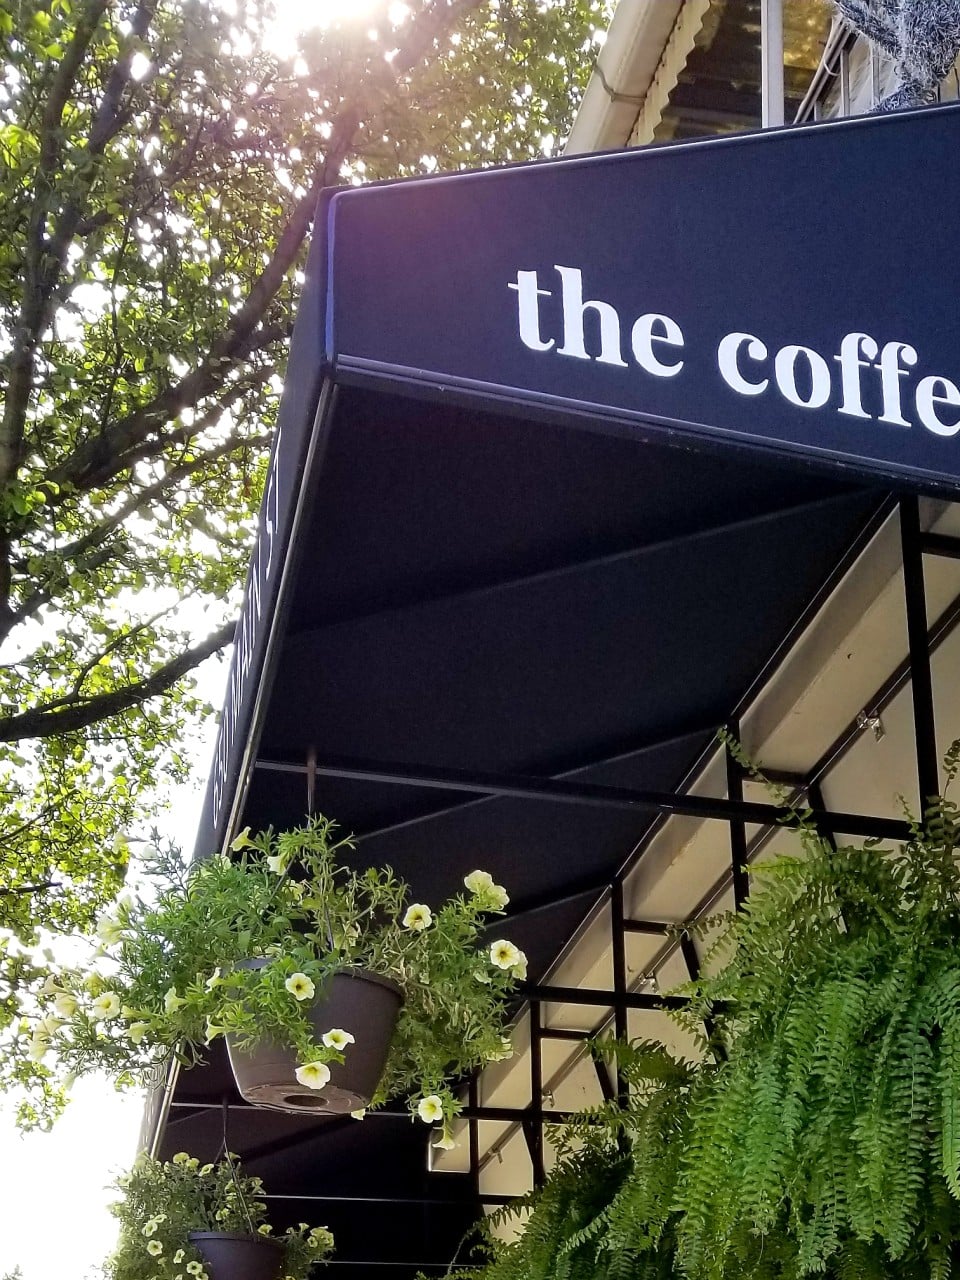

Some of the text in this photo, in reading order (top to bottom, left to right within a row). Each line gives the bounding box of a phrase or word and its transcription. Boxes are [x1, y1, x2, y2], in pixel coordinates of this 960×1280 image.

[507, 264, 685, 377] the
[231, 533, 261, 747] MAIN
[265, 426, 282, 581] ST
